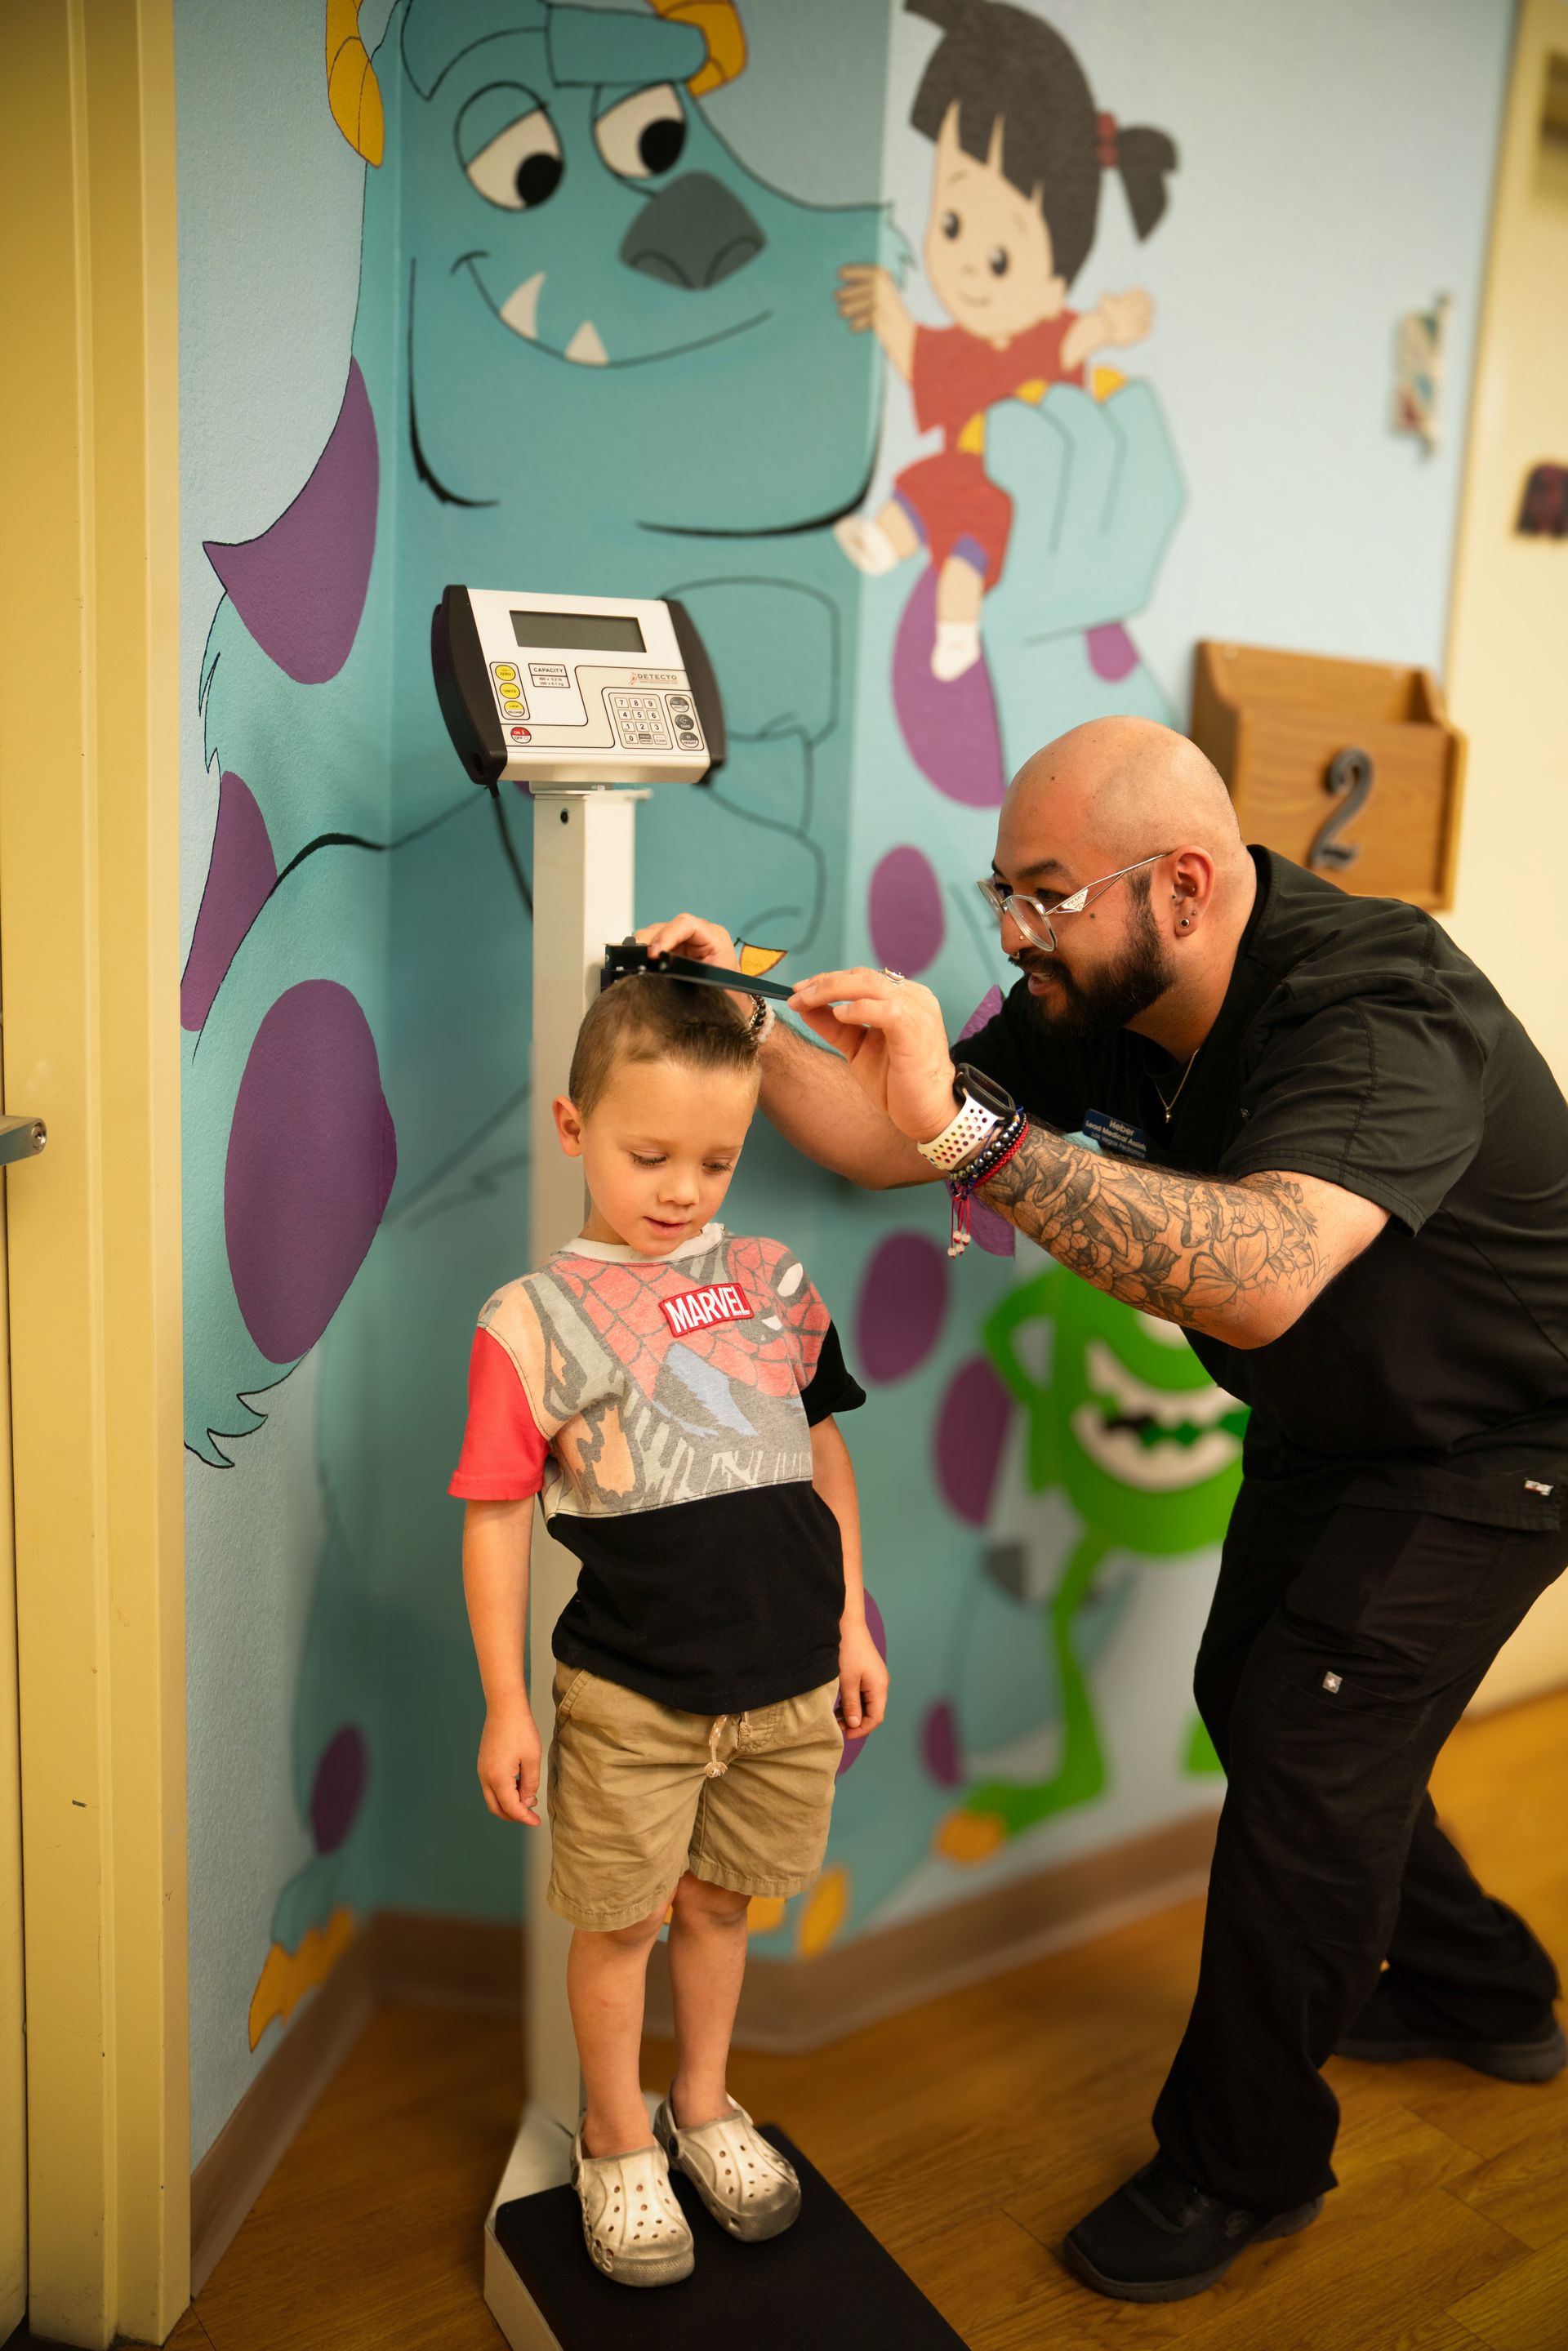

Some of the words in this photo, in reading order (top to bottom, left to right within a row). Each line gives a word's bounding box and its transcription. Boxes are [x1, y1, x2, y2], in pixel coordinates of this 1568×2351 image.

[1309, 745, 1373, 871] 2
[1067, 893, 1085, 906] PRADA
[1085, 1120, 1102, 1132] Lead
[1102, 1127, 1128, 1142] Medical
[1109, 1119, 1134, 1136] Heber
[664, 1285, 751, 1334] MARVEL
